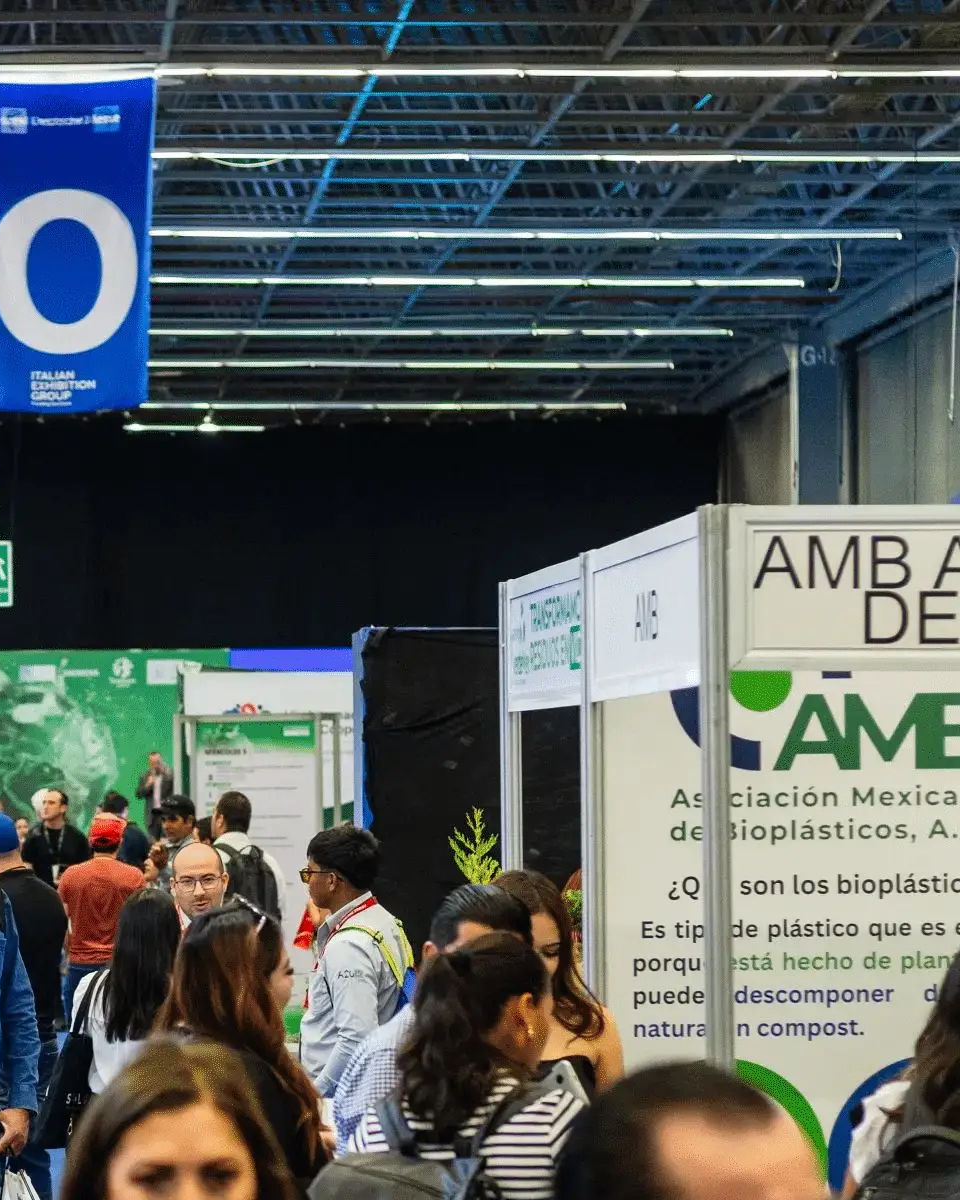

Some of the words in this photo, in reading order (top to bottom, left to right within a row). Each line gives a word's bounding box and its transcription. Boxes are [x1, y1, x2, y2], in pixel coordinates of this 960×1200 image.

[31, 391, 72, 400] GROUP
[753, 535, 911, 589] AMB
[670, 785, 838, 809] Asciación
[740, 879, 784, 895] son
[793, 874, 829, 895] los
[641, 920, 666, 939] Es
[674, 920, 704, 943] tip
[730, 919, 758, 938] de
[768, 918, 859, 943] plástico
[869, 922, 912, 941] que
[921, 922, 946, 936] es
[633, 957, 705, 977] porqu
[783, 952, 853, 970] hecho
[863, 952, 891, 970] de
[735, 984, 894, 1008] descomponer
[757, 1020, 865, 1041] compost.
